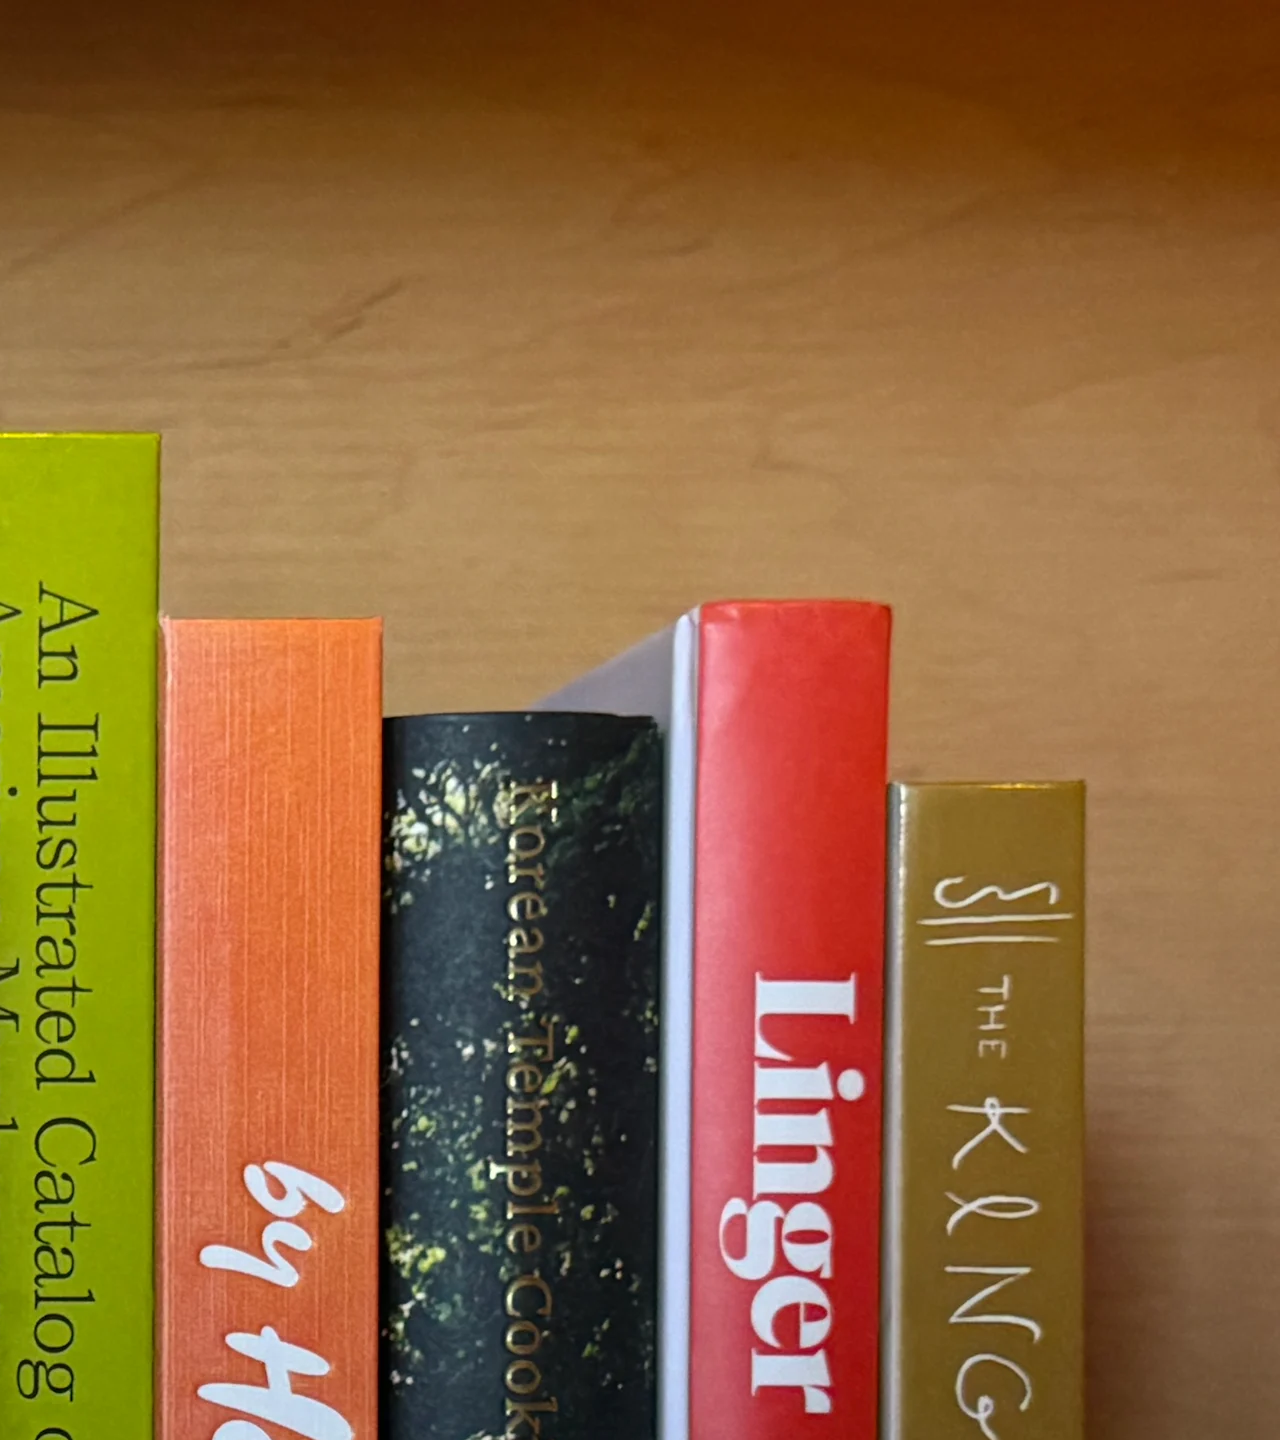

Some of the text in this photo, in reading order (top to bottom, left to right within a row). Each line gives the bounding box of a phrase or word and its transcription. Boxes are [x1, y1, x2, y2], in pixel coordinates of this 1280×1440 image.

[38, 580, 99, 690] An
[32, 712, 99, 1090] Illustrated
[508, 780, 558, 1001] Korean
[977, 975, 1010, 1059] THE
[199, 1160, 345, 1288] by
[489, 1018, 558, 1254] Temple
[719, 971, 865, 1415] Linger
[16, 1115, 96, 1403] Catalog
